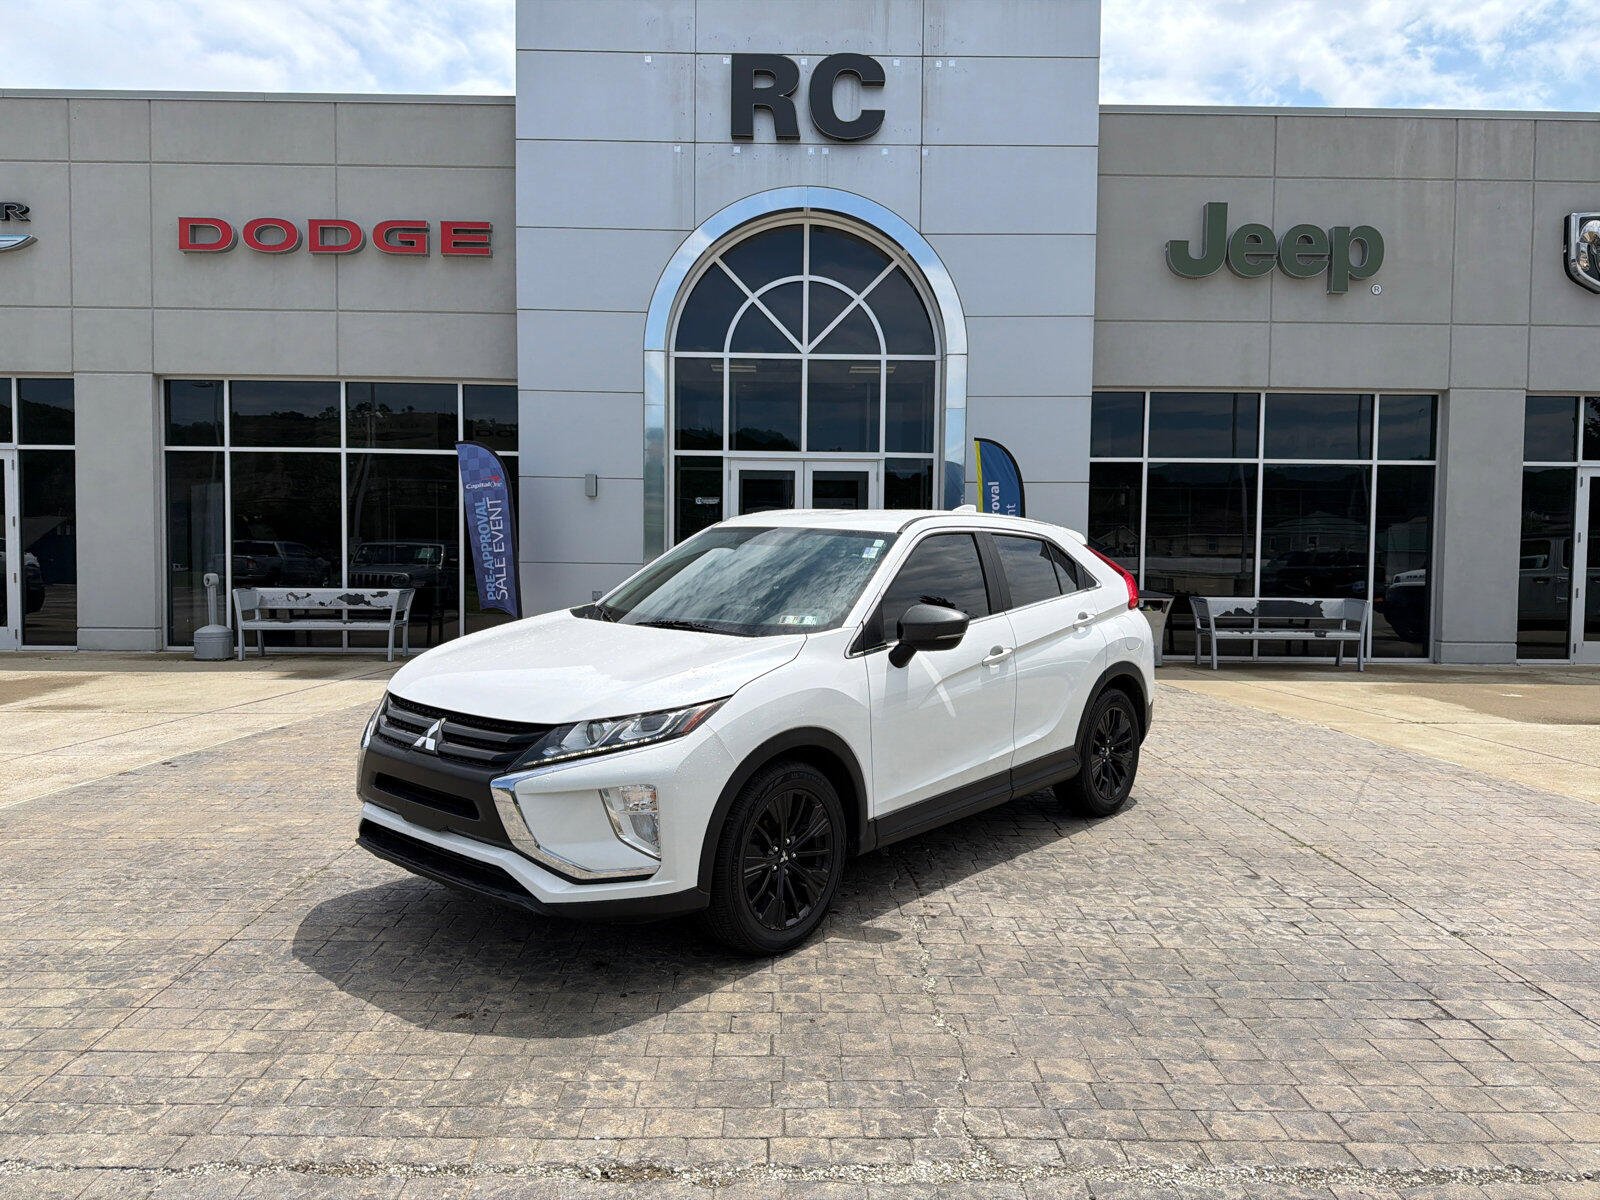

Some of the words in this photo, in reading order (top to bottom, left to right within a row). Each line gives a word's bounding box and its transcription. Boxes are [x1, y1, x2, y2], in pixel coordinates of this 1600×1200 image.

[731, 53, 886, 141] RC
[178, 216, 493, 257] DODGE
[1165, 202, 1385, 295] Jeep
[475, 498, 496, 600] PRE-APPROVAL
[487, 497, 504, 553] EVENT
[494, 557, 509, 600] SALE
